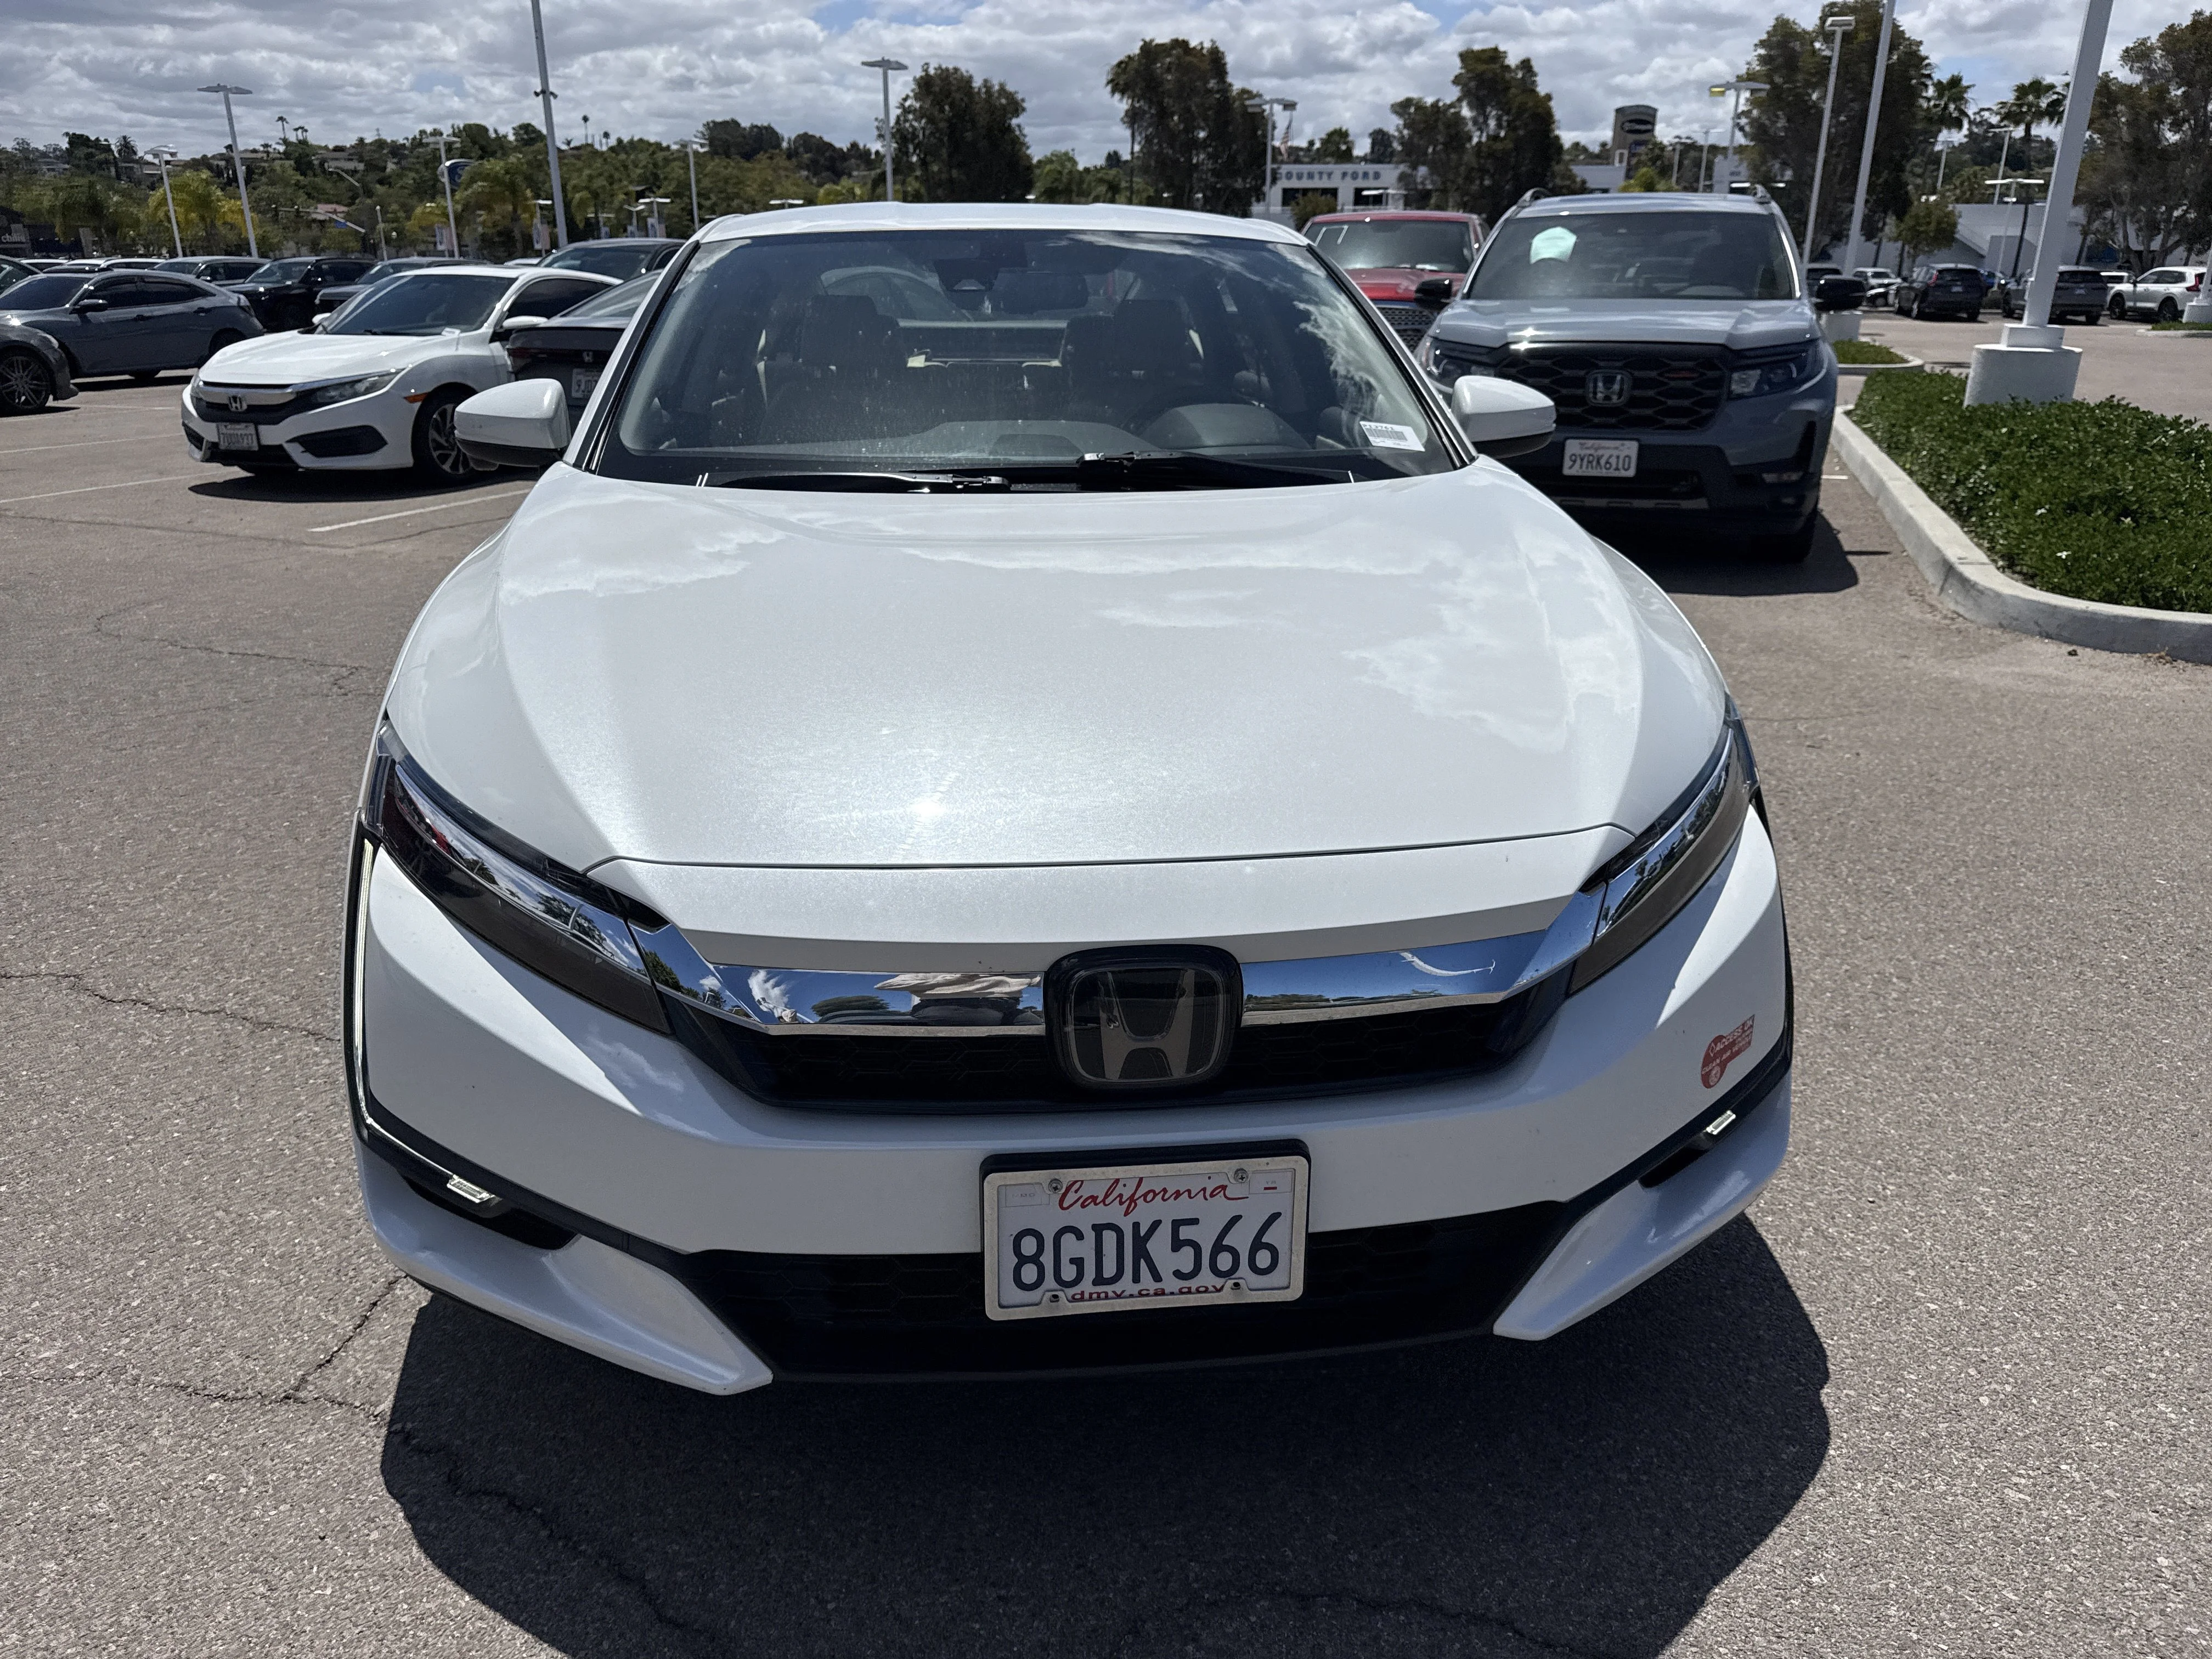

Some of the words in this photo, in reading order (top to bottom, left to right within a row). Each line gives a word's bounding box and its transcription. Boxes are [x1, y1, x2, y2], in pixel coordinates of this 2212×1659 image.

[1341, 171, 1381, 180] FORD
[1568, 453, 1632, 471] 9YRK610
[1058, 1177, 1249, 1216] California
[1012, 1211, 1283, 1291] 8GDK566
